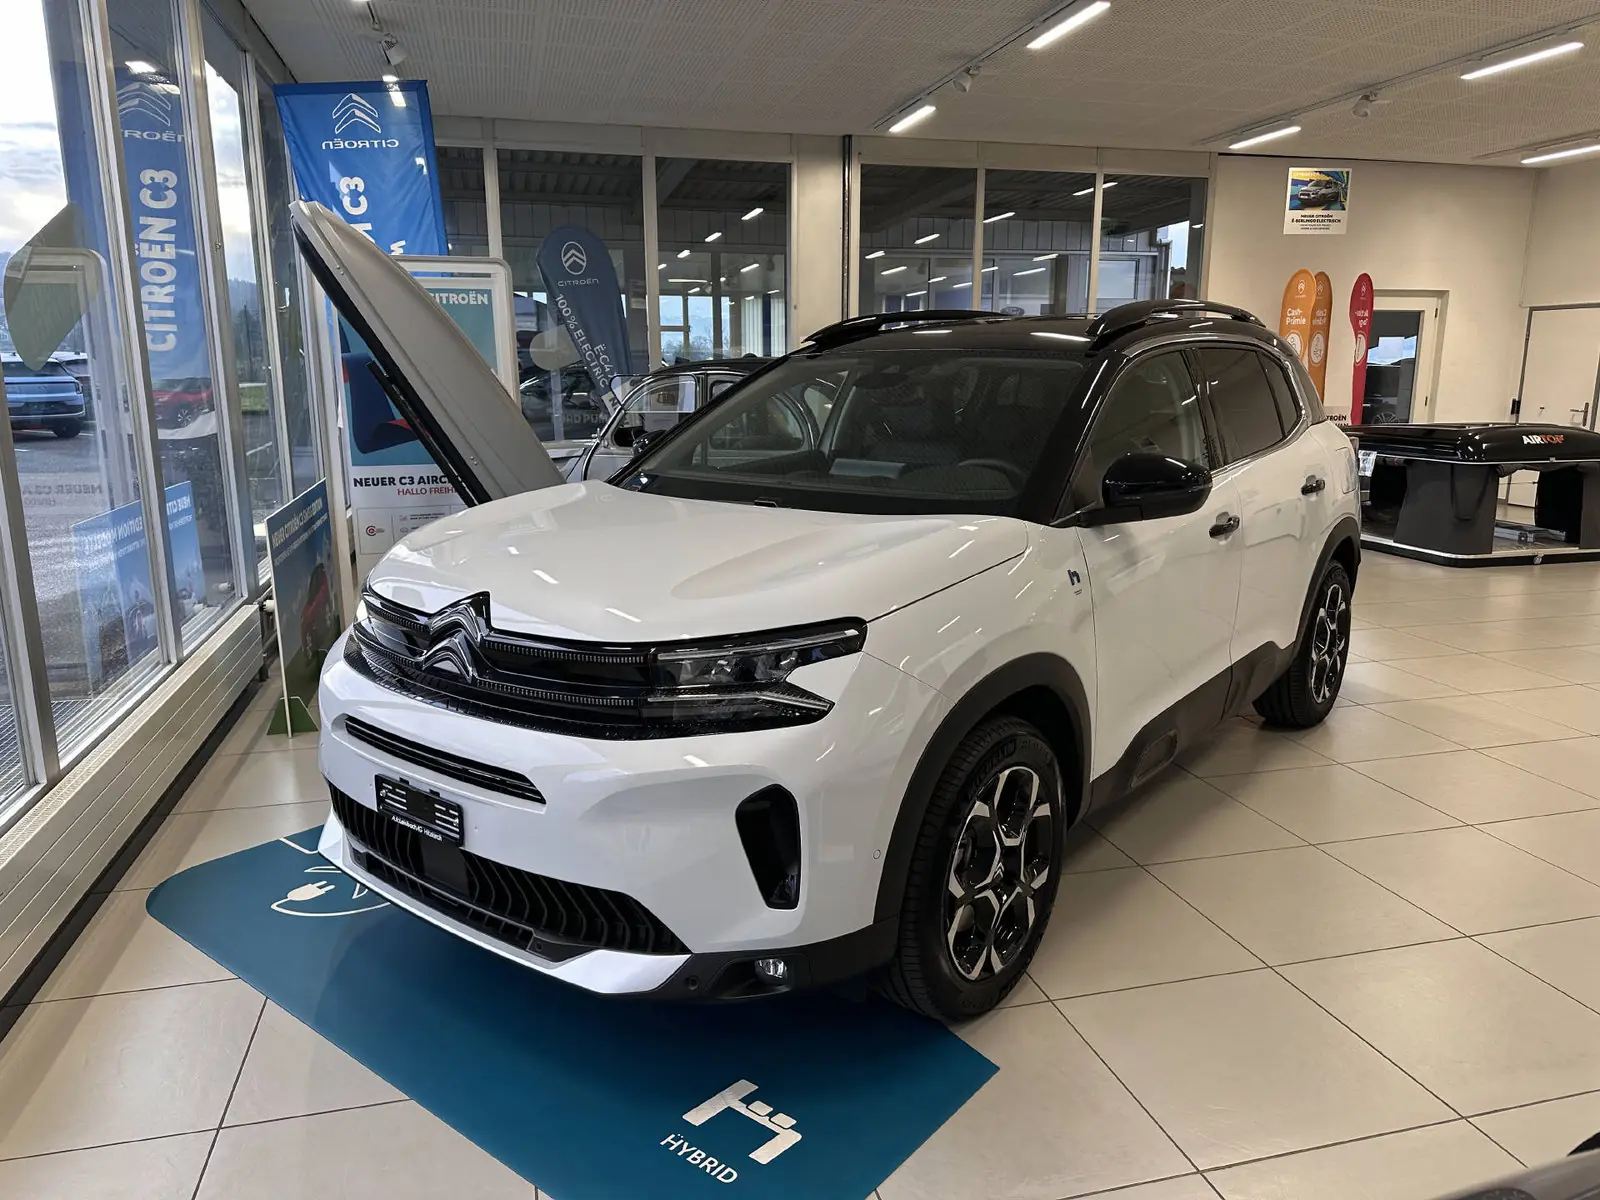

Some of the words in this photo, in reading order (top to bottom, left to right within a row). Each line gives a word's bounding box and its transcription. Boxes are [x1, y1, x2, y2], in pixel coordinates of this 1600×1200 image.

[139, 168, 178, 210] C3
[135, 216, 178, 353] CITROËN
[555, 293, 578, 329] 100%
[573, 329, 608, 389] ELECTRIC
[353, 476, 397, 487] NEUER
[399, 475, 414, 486] C3
[417, 475, 451, 485] AIRC
[397, 487, 428, 496] HALLO
[429, 486, 458, 495] FREIH
